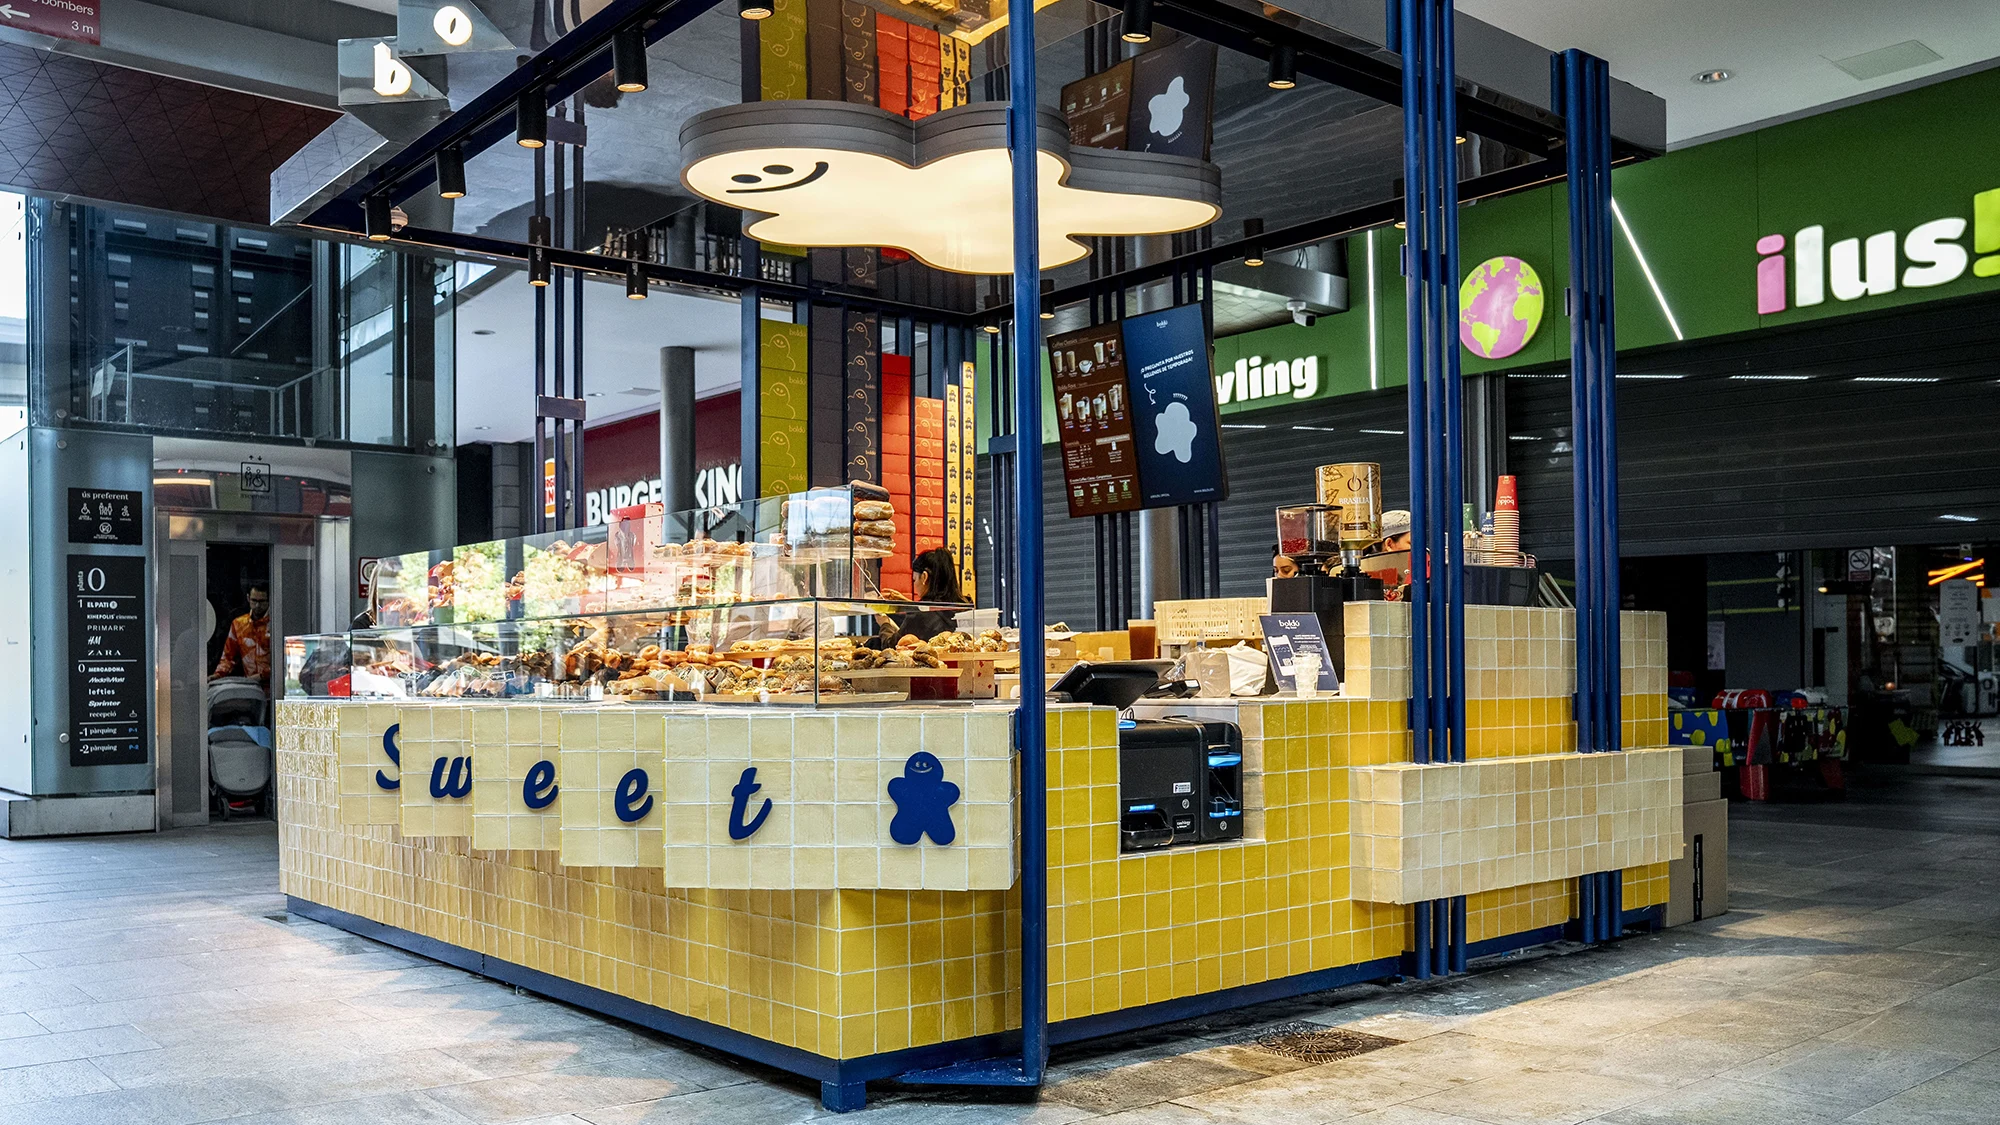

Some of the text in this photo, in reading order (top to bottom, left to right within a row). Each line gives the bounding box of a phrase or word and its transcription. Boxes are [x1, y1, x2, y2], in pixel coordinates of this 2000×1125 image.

[72, 20, 94, 34] 3 m
[586, 478, 662, 526] BURGE
[87, 567, 105, 592] 0
[78, 599, 82, 608] 1
[78, 663, 85, 673] 0
[79, 727, 87, 736] -1
[80, 745, 89, 754] -2
